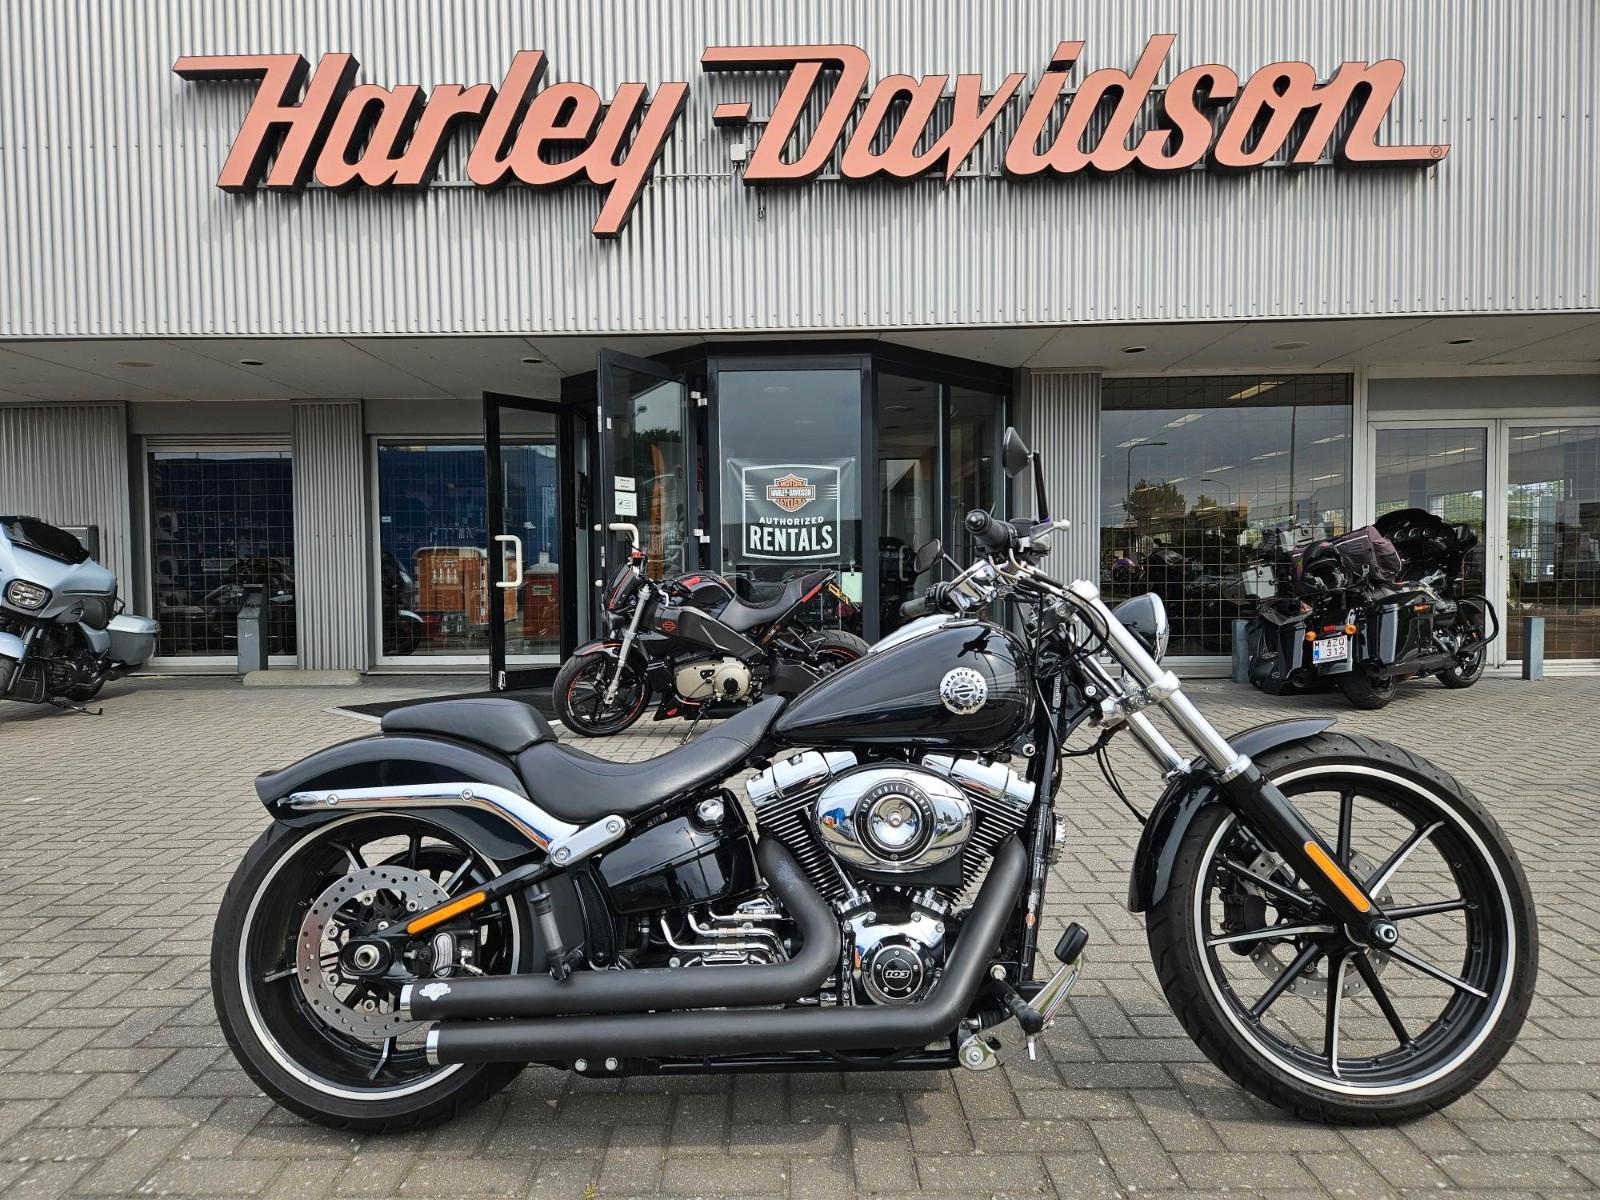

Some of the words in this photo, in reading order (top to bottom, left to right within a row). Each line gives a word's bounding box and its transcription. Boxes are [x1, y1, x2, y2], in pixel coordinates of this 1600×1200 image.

[759, 516, 824, 525] AUTHORIZED
[749, 525, 833, 552] RENTALS
[1327, 646, 1345, 657] 312
[872, 785, 899, 797] CUBIC
[905, 787, 930, 816] INCHES
[885, 970, 910, 978] 103
